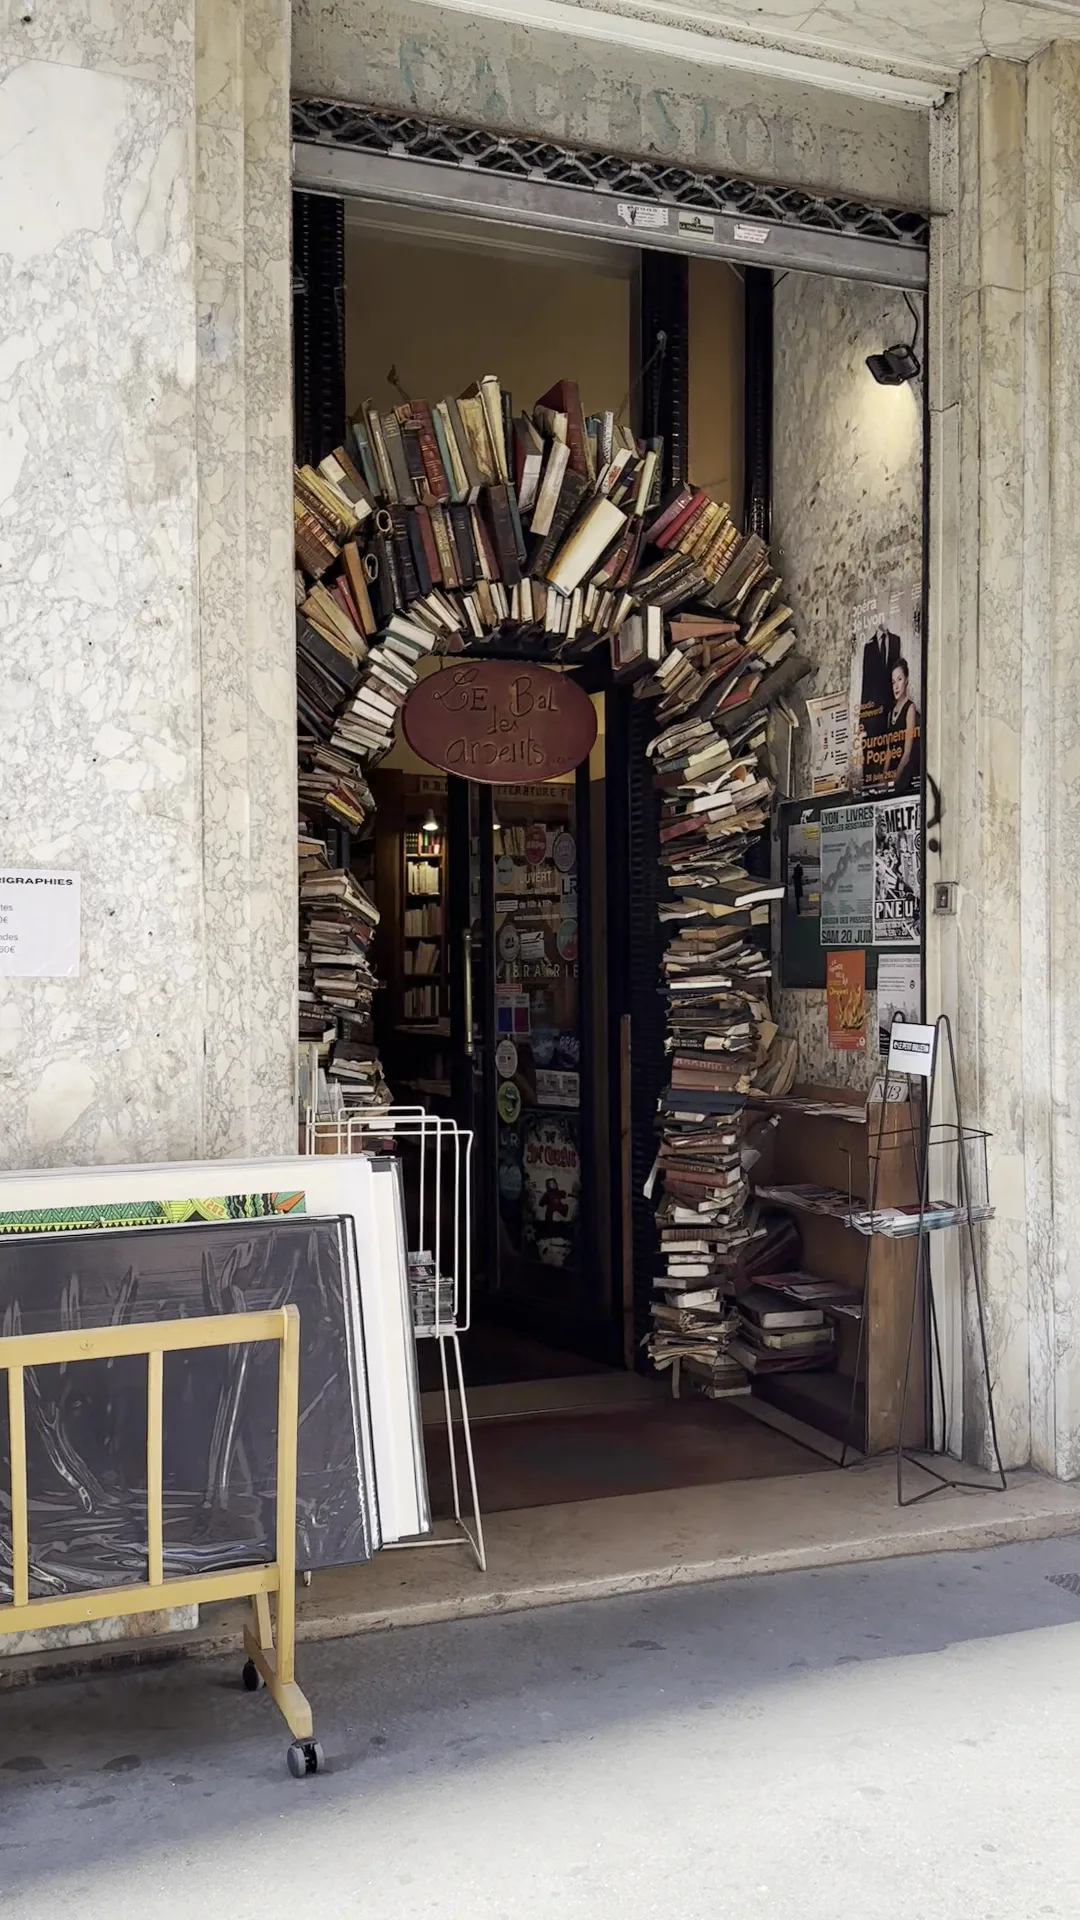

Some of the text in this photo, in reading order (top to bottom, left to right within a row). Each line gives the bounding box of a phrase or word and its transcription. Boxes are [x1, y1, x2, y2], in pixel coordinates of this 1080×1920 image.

[863, 612, 885, 630] Lyon
[853, 722, 865, 735] Le
[866, 745, 903, 764] Poppée
[821, 810, 839, 825] LYON
[846, 806, 874, 822] LIVRES
[0, 877, 73, 886] IGRAPHIES
[875, 900, 913, 918] PNEU
[841, 929, 852, 943] 20
